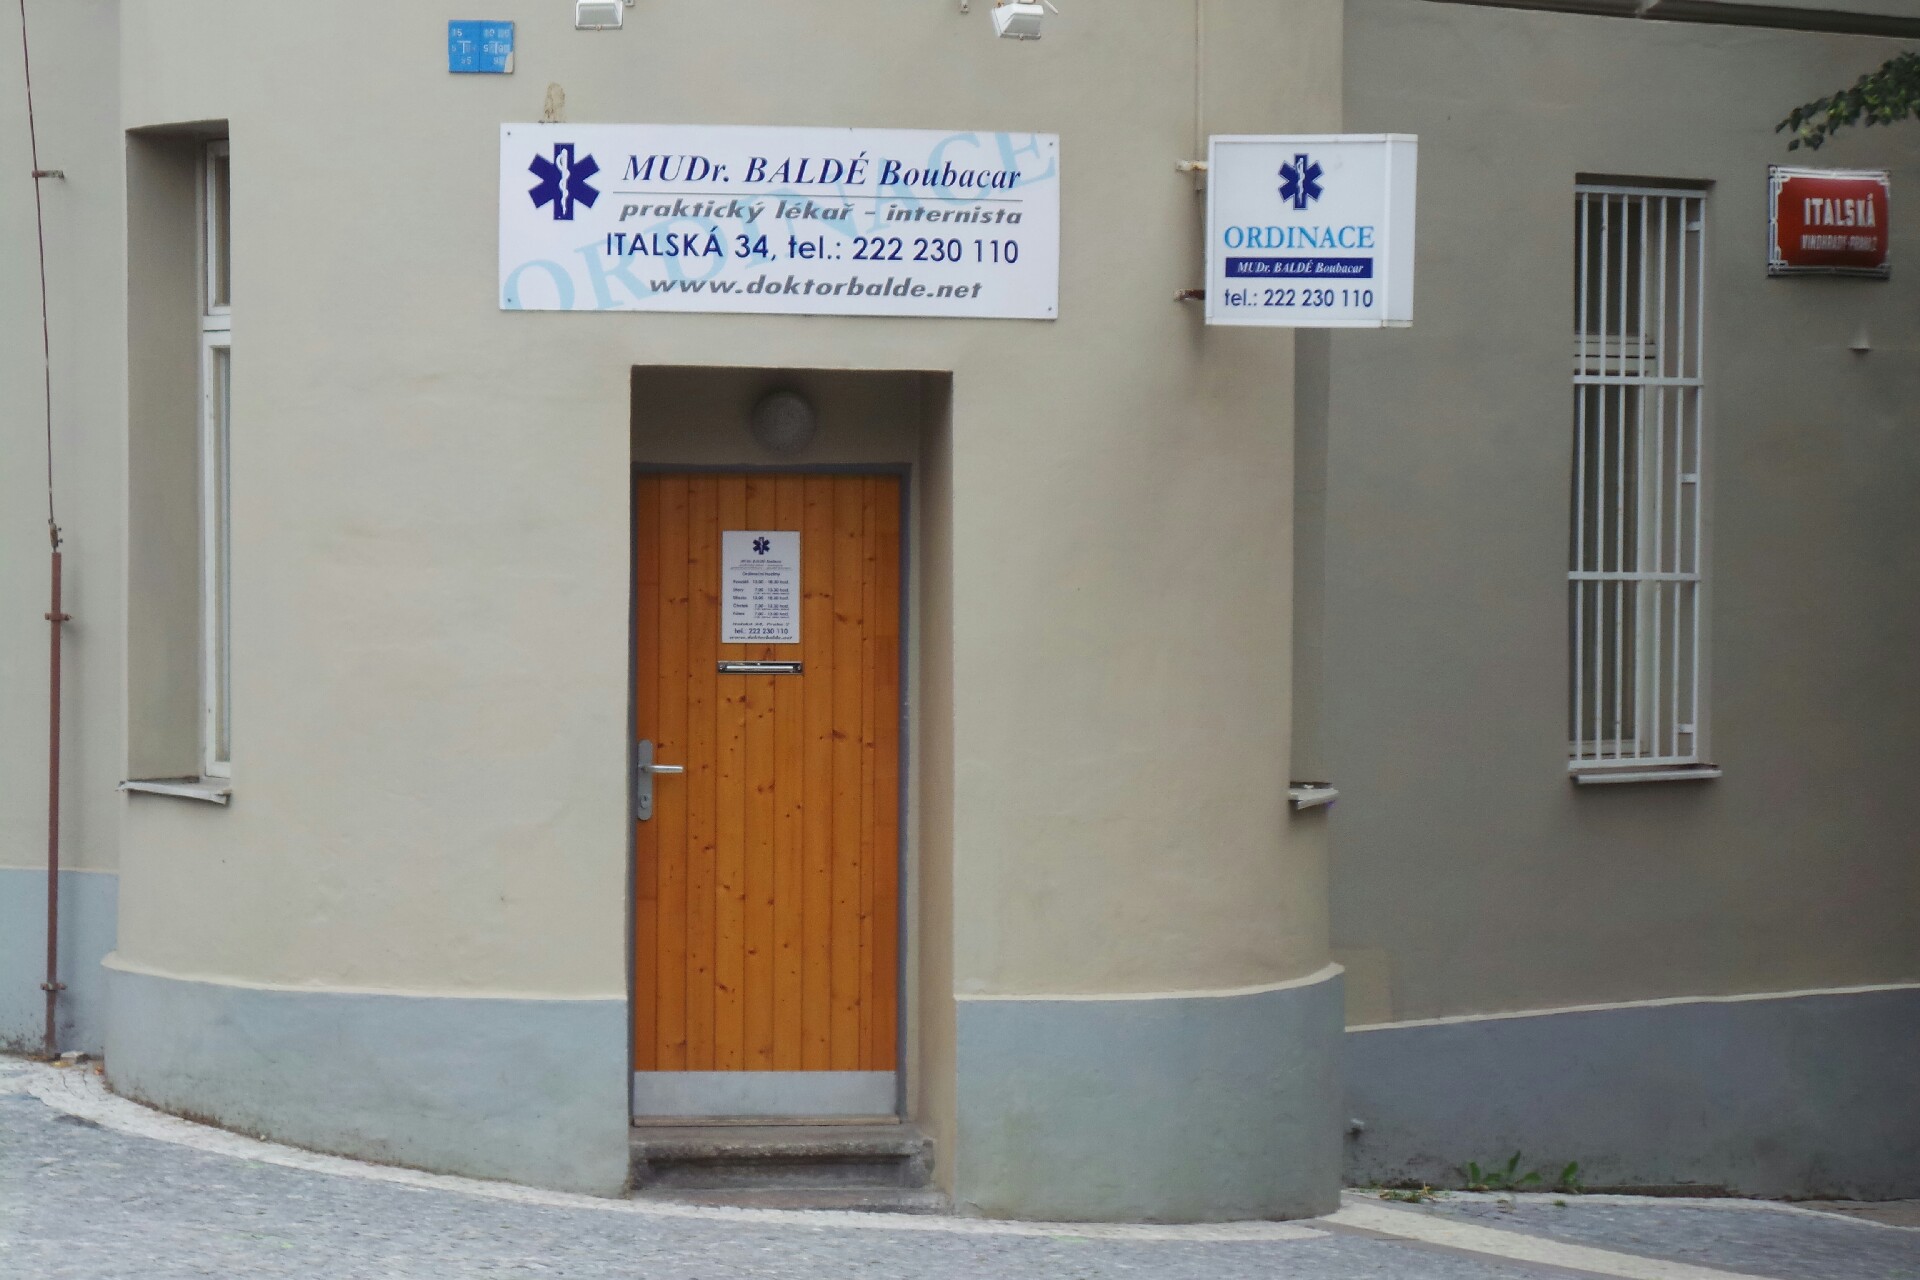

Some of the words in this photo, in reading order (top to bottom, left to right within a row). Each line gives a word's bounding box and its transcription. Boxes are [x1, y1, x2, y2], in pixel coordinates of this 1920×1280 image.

[621, 154, 730, 183] MUDr.
[742, 151, 869, 185] BALDÉ
[878, 158, 1022, 189] Boubacar
[618, 198, 765, 224] praktický
[775, 199, 854, 221] lékař
[886, 203, 1022, 225] internista
[1804, 192, 1876, 227] ITALSKÁ
[606, 226, 724, 257] ITALSKÁ
[734, 234, 777, 261] 34,
[788, 235, 841, 260] tel.:
[852, 236, 904, 261] 222
[913, 237, 963, 263] 230
[974, 239, 1019, 264] 110
[1224, 225, 1375, 249] ORDINACE
[1237, 261, 1271, 273] MUDr.
[1273, 259, 1313, 273] BALDÉ
[1315, 261, 1364, 274] Boubacar
[649, 274, 983, 299] www.doktorbalde.net
[1225, 288, 1258, 307] tel.:
[1263, 289, 1295, 307] 222
[1302, 289, 1334, 307] 230
[1342, 289, 1374, 308] 110
